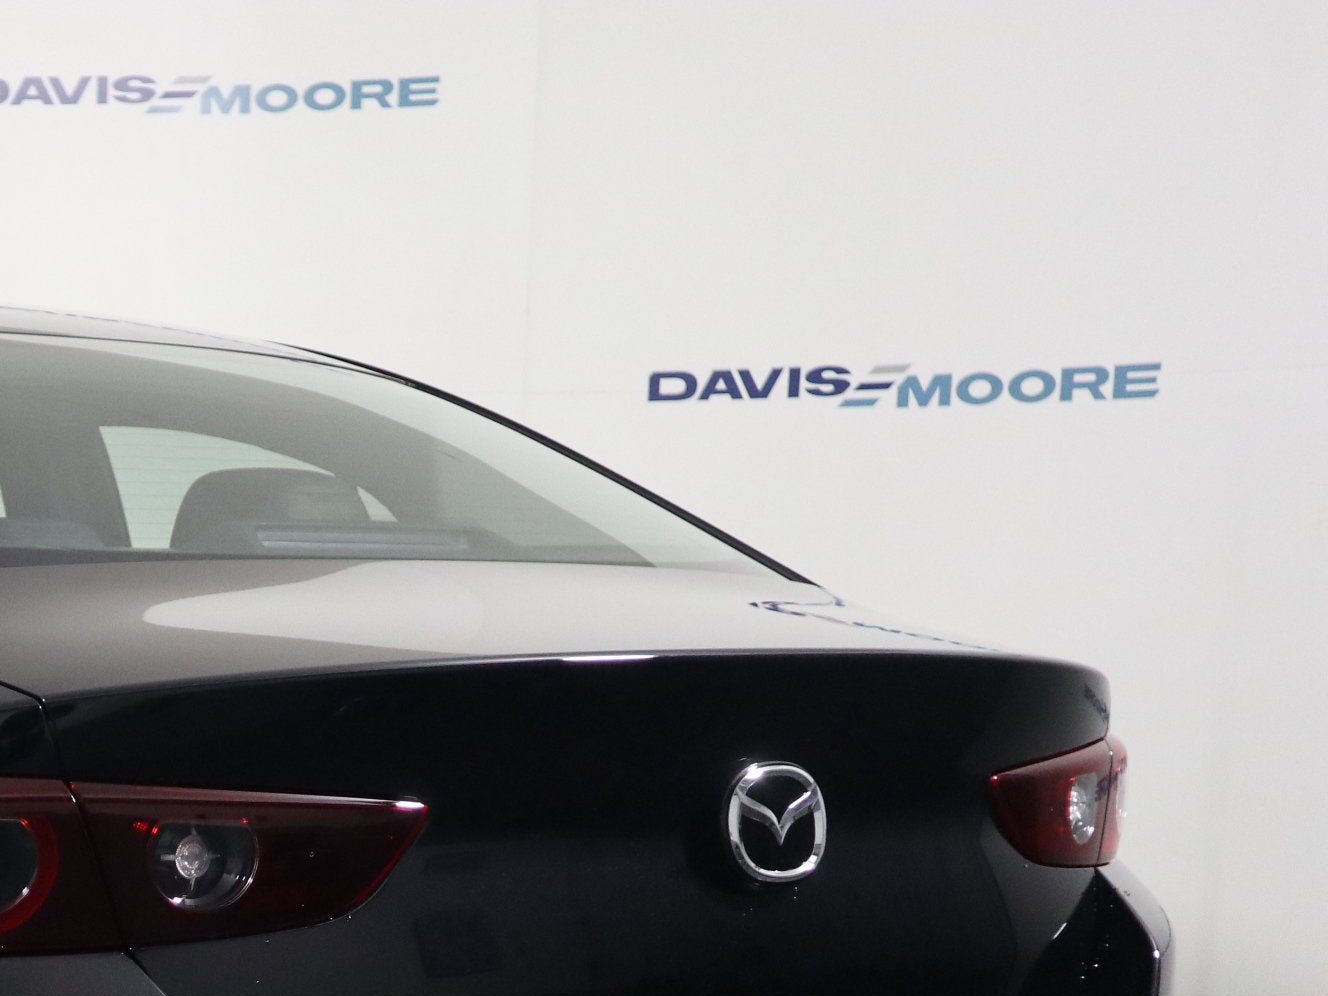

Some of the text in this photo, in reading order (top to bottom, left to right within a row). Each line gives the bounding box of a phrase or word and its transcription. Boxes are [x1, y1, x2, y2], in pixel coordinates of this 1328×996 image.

[200, 75, 441, 114] MOORE
[648, 362, 1162, 408] DAVIS MOORE
